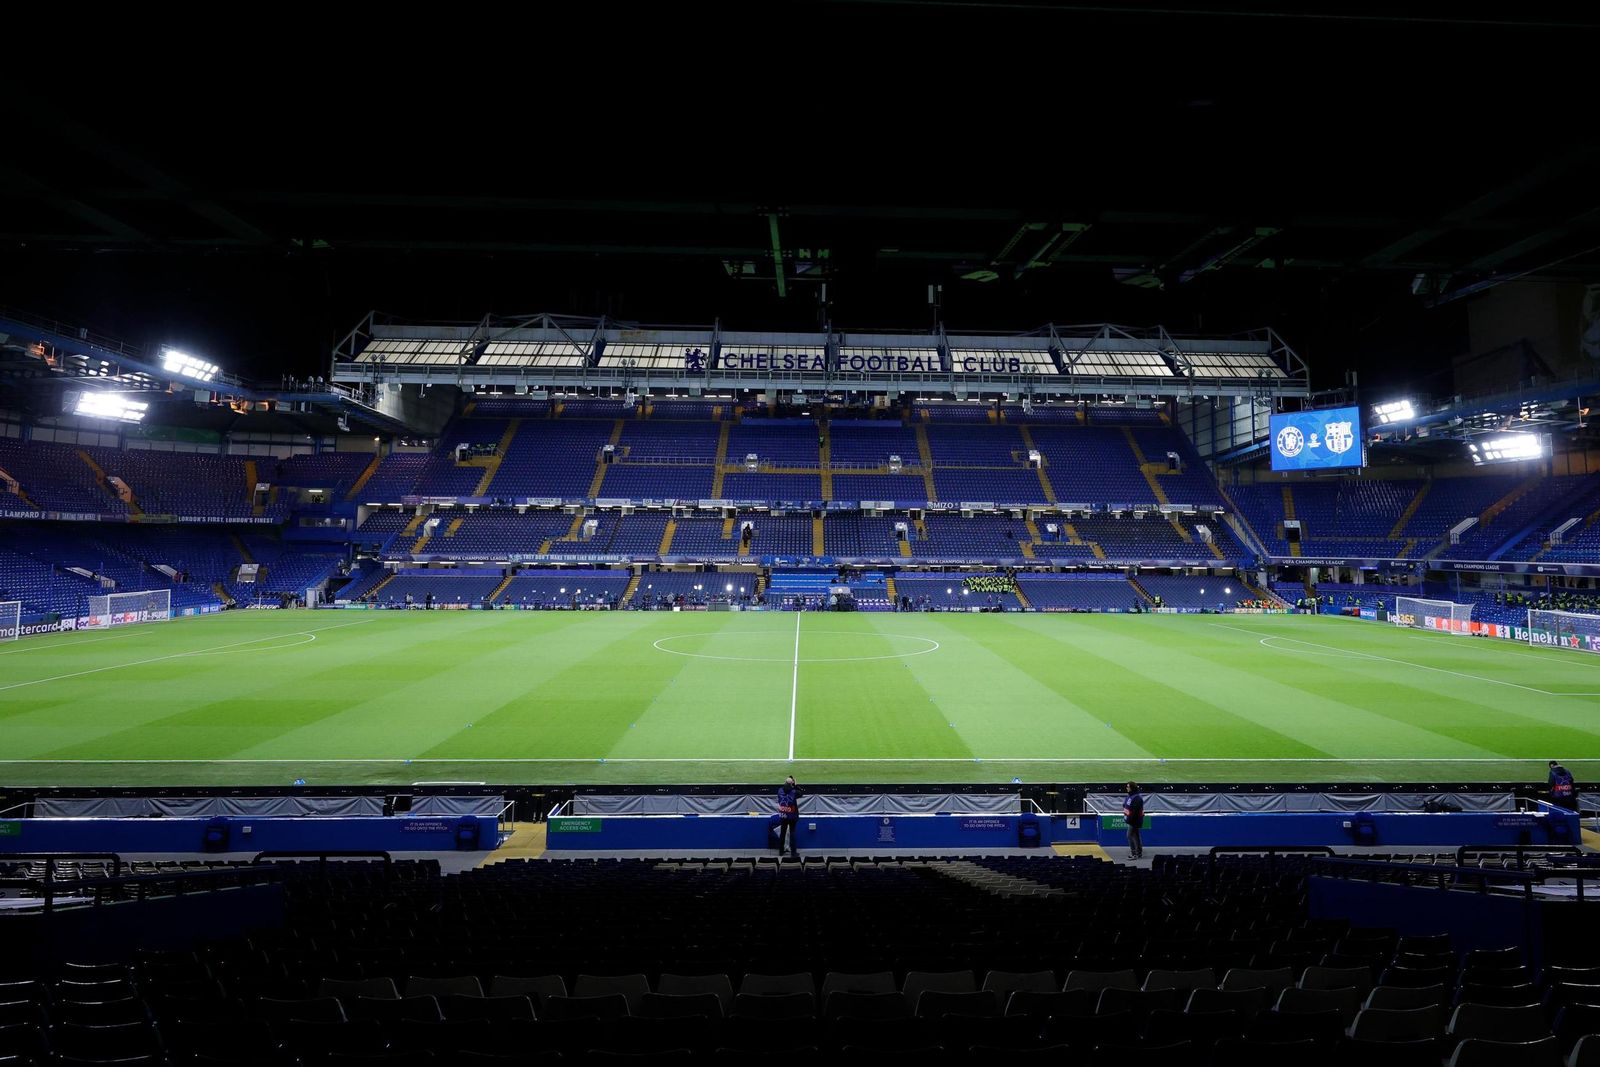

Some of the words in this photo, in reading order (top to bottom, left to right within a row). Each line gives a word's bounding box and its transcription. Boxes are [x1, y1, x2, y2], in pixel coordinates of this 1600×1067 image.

[724, 353, 826, 370] CHELSEA
[837, 354, 951, 372] FOOTBALL
[964, 357, 1021, 372] CLUB
[4, 510, 39, 519] LAMPARD
[1514, 627, 1569, 647] Heneken
[1069, 817, 1077, 826] 4
